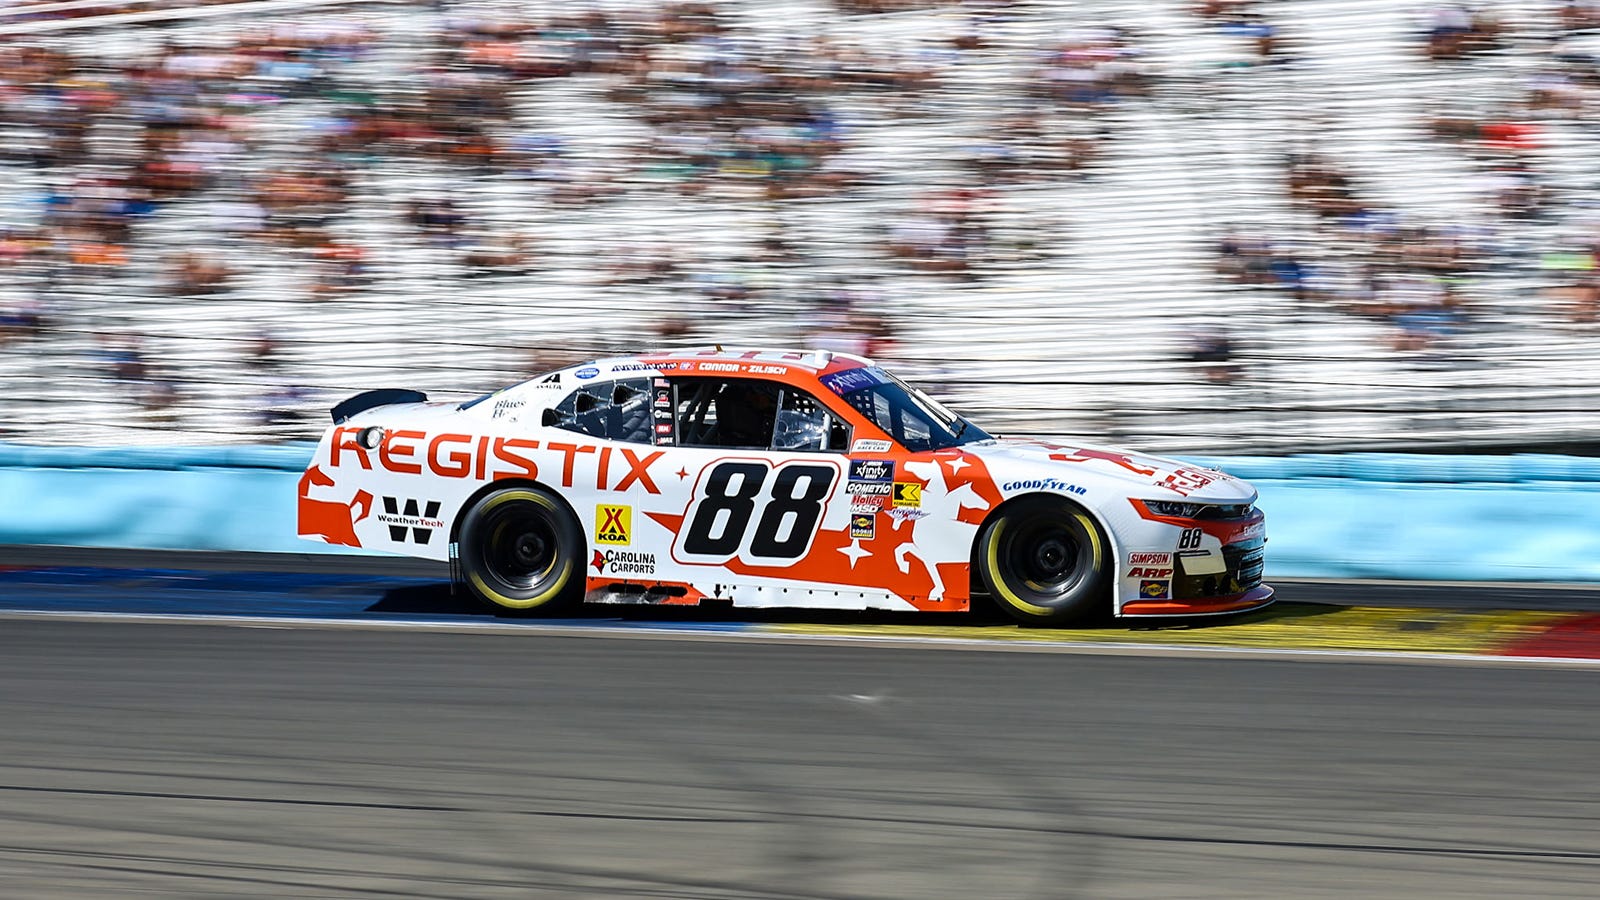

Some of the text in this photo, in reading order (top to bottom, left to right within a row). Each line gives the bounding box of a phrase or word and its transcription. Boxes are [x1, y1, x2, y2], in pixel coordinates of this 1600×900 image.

[699, 362, 787, 375] CONNOR ZILISCH
[330, 427, 667, 495] REGISTIX
[856, 464, 887, 477] xfinity
[1003, 478, 1087, 495] GOODYEAR
[684, 462, 835, 559] 88
[378, 514, 443, 528] WeatherTech
[598, 533, 627, 542] KOA
[1178, 529, 1202, 549] 88
[605, 549, 656, 564] CAROLINA
[1130, 553, 1169, 564] SIMPSON
[610, 562, 655, 574] CARPORTS
[1127, 567, 1173, 578] ARP
